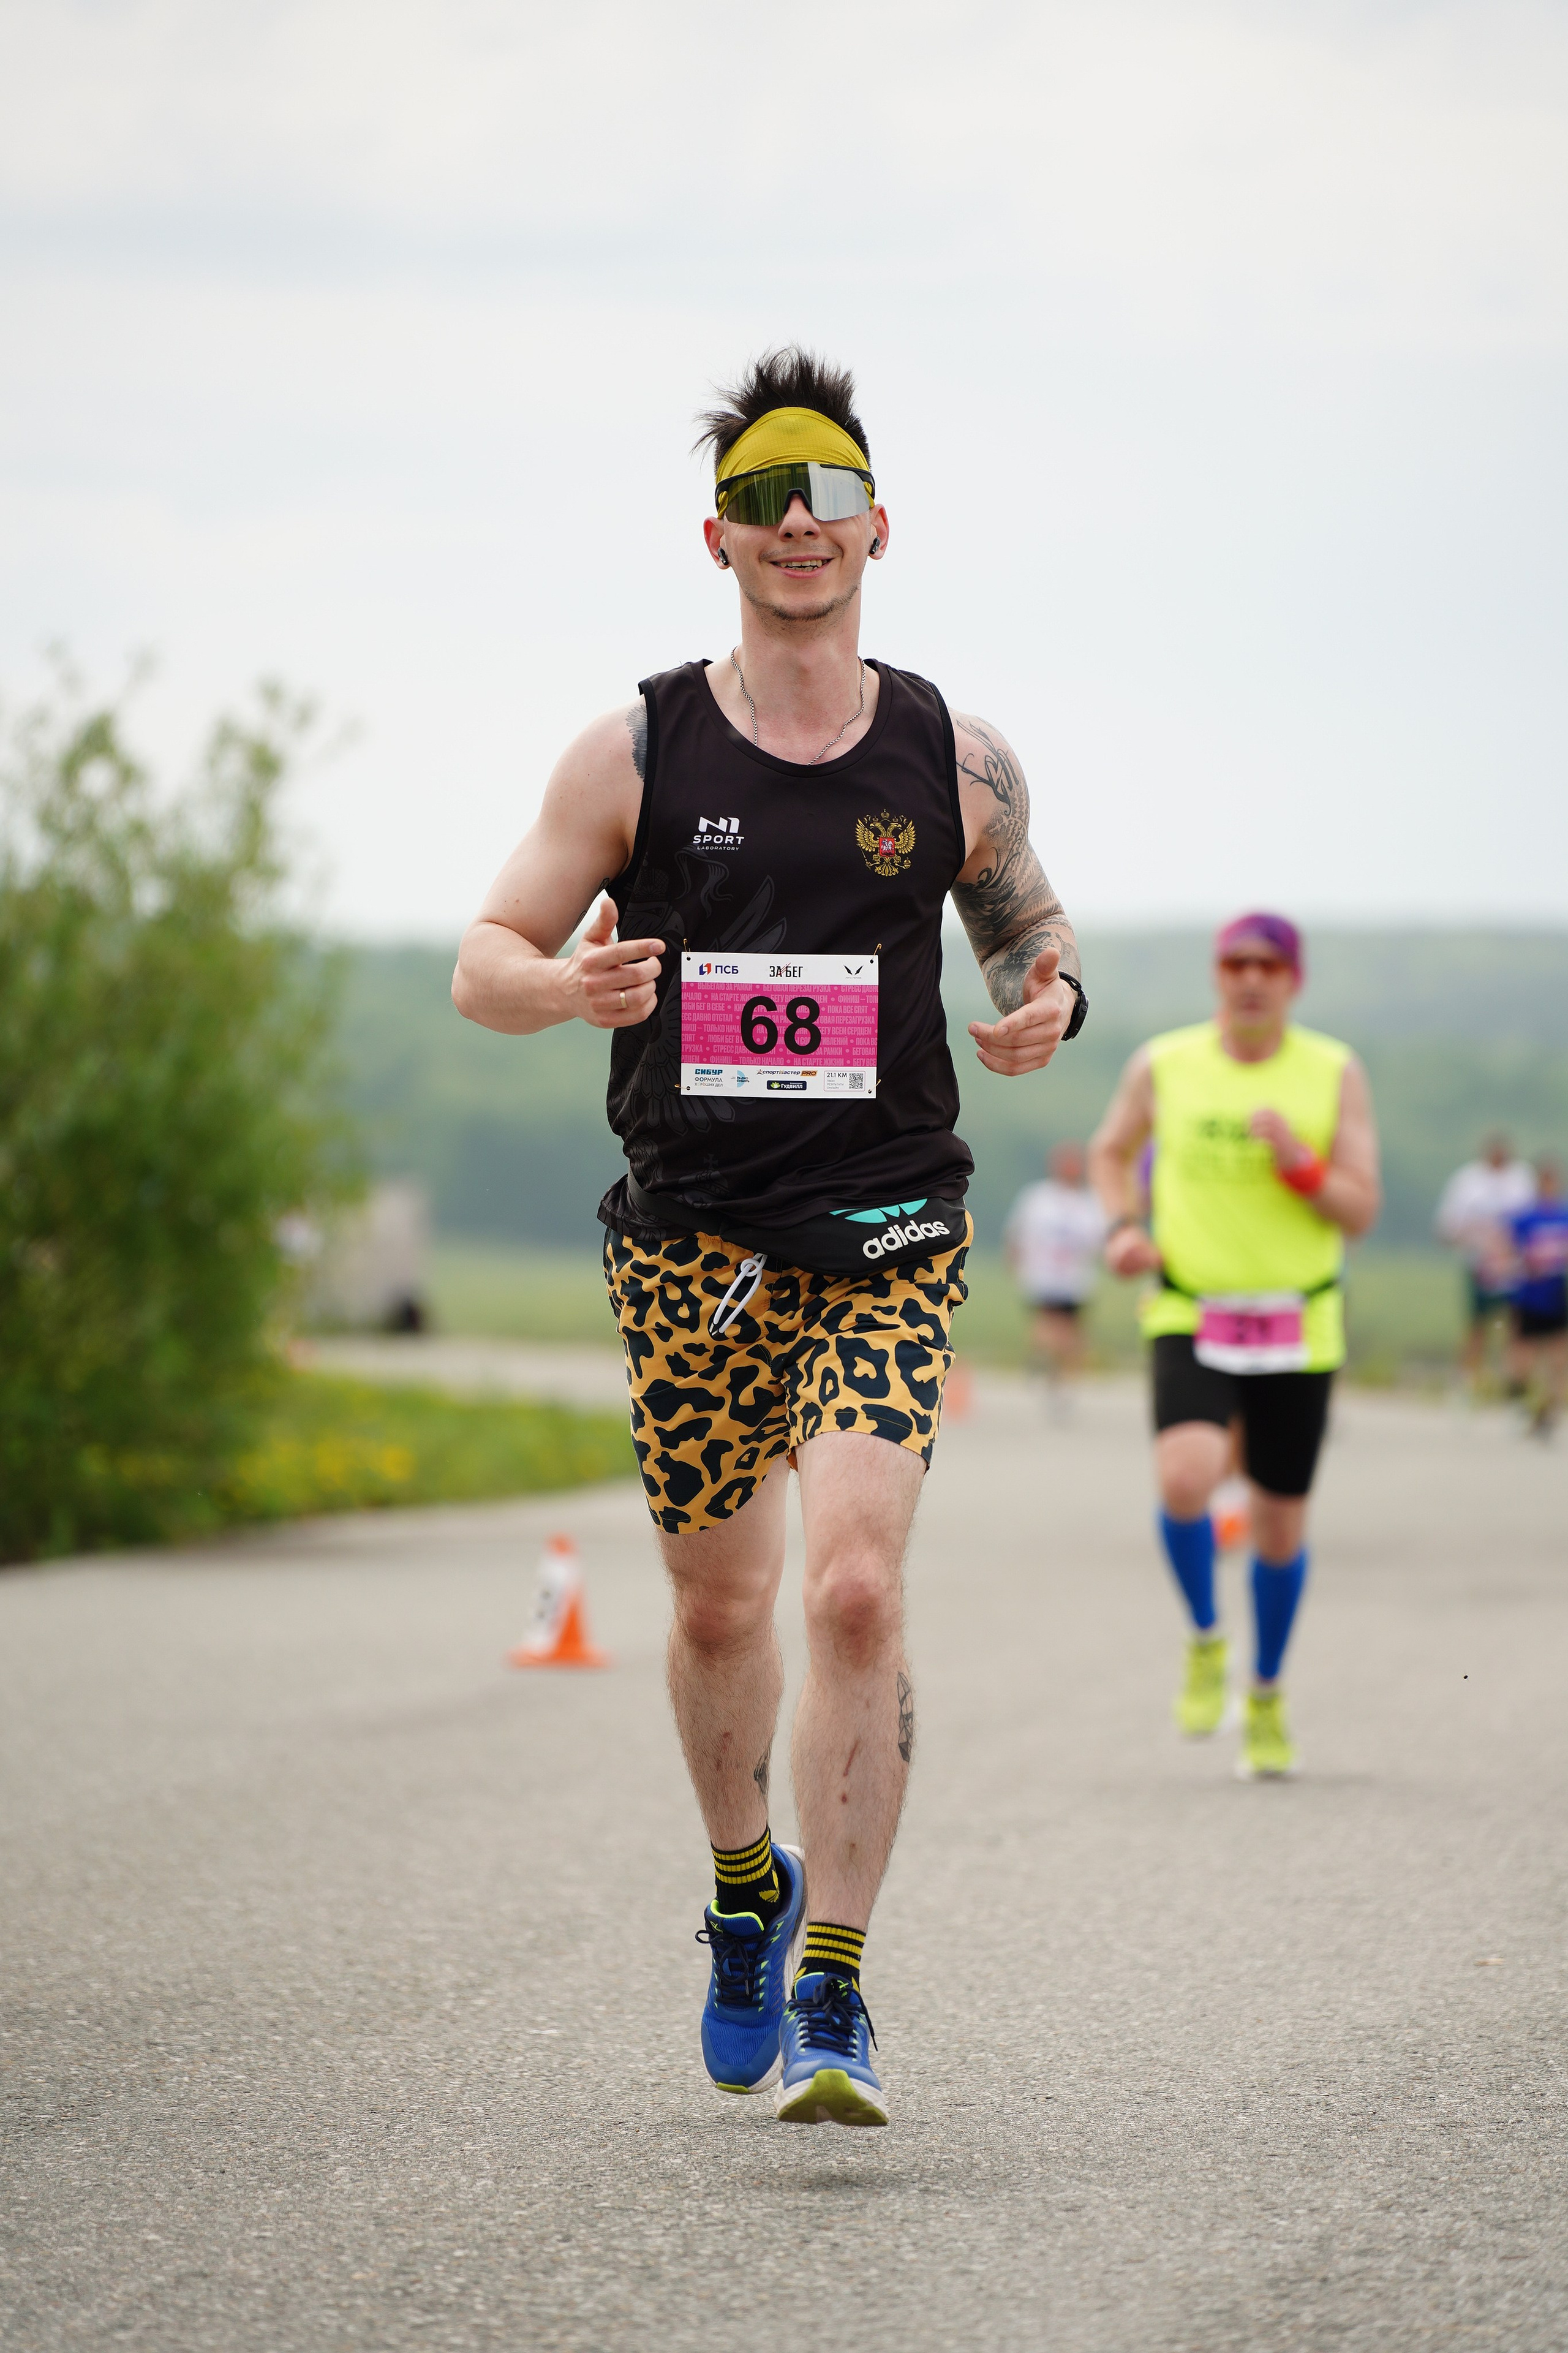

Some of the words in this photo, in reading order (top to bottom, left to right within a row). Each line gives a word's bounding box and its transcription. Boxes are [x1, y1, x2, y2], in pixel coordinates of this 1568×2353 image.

[693, 835, 745, 844] SPORT
[715, 965, 739, 974] ПСБ
[719, 993, 739, 1002] СТАРТЕ
[827, 1005, 843, 1014] ПОКА
[843, 1005, 854, 1014] ВСЕ
[692, 1013, 711, 1022] ДАВНО
[835, 1016, 875, 1024] ПЕРЕЗАГРУЗКА
[704, 1024, 725, 1033] ТОЛЬКО
[847, 1027, 872, 1036] СЕРДЦЕМ
[741, 995, 821, 1056] 68
[856, 1037, 871, 1046] ПОКА
[713, 1044, 734, 1053] СТРЕСС
[823, 1047, 843, 1056] РАМКИ
[710, 1055, 733, 1064] ФИНИШ
[739, 1056, 761, 1065] ТОЛЬКО
[761, 1057, 785, 1065] НАЧАЛО
[793, 1057, 802, 1066] НА
[802, 1057, 823, 1066] СТАРТЕ
[853, 1058, 866, 1067] БЕГУ
[862, 1220, 951, 1260] adidas
